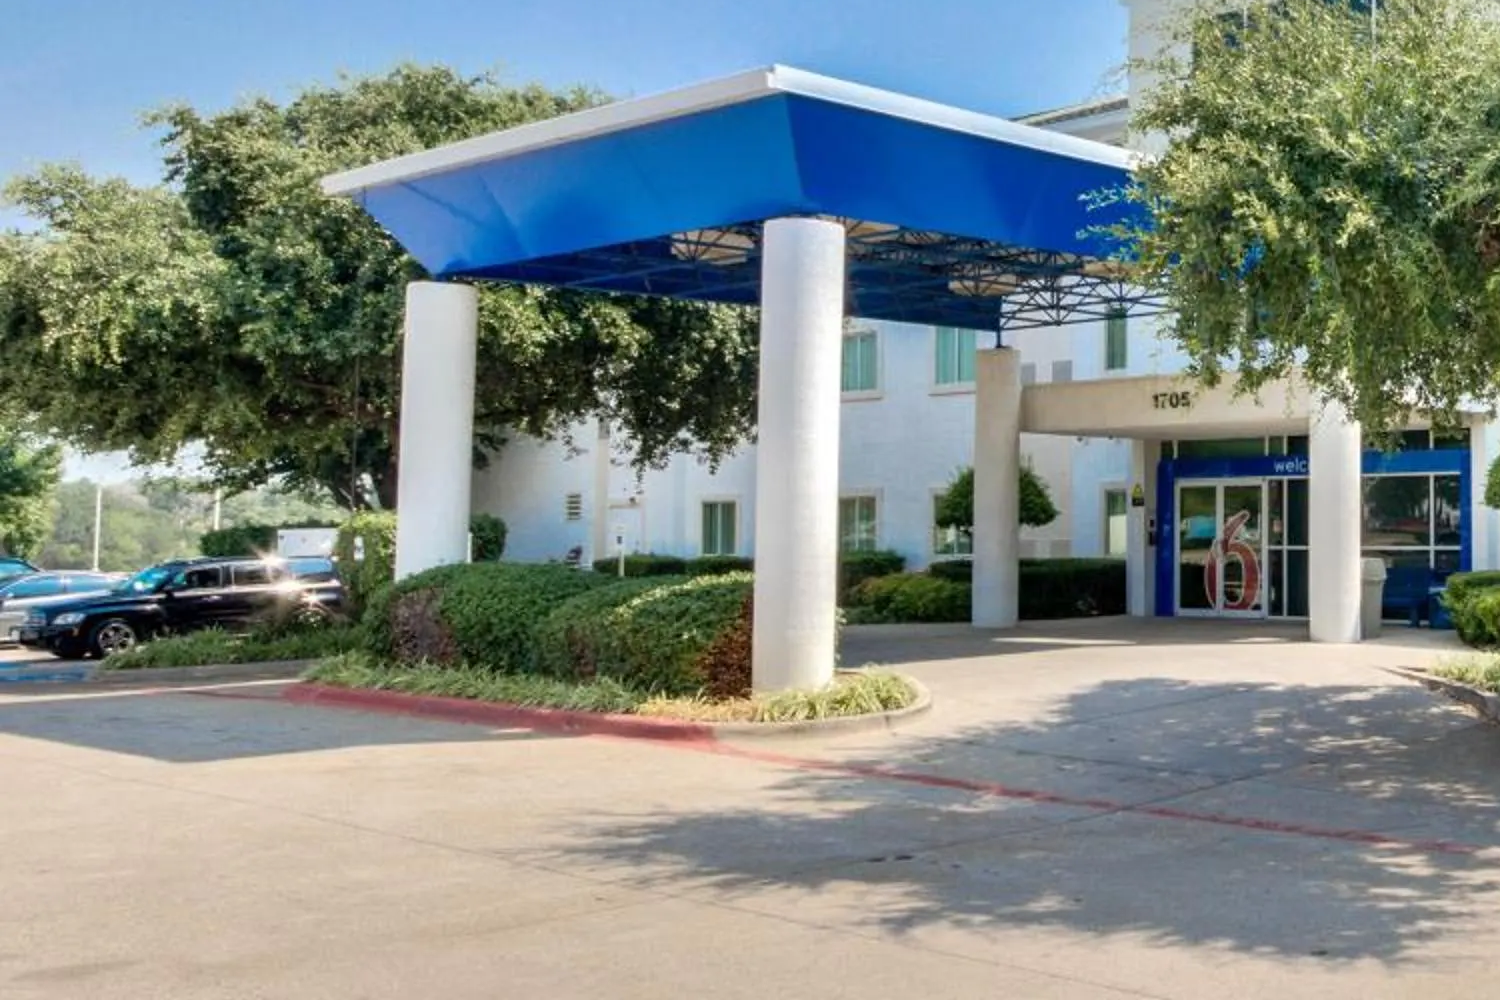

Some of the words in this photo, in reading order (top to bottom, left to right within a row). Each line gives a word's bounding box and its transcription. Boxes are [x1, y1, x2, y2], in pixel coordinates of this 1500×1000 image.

[1152, 391, 1191, 409] 1705
[1274, 455, 1308, 473] welc
[1204, 510, 1261, 612] 6
